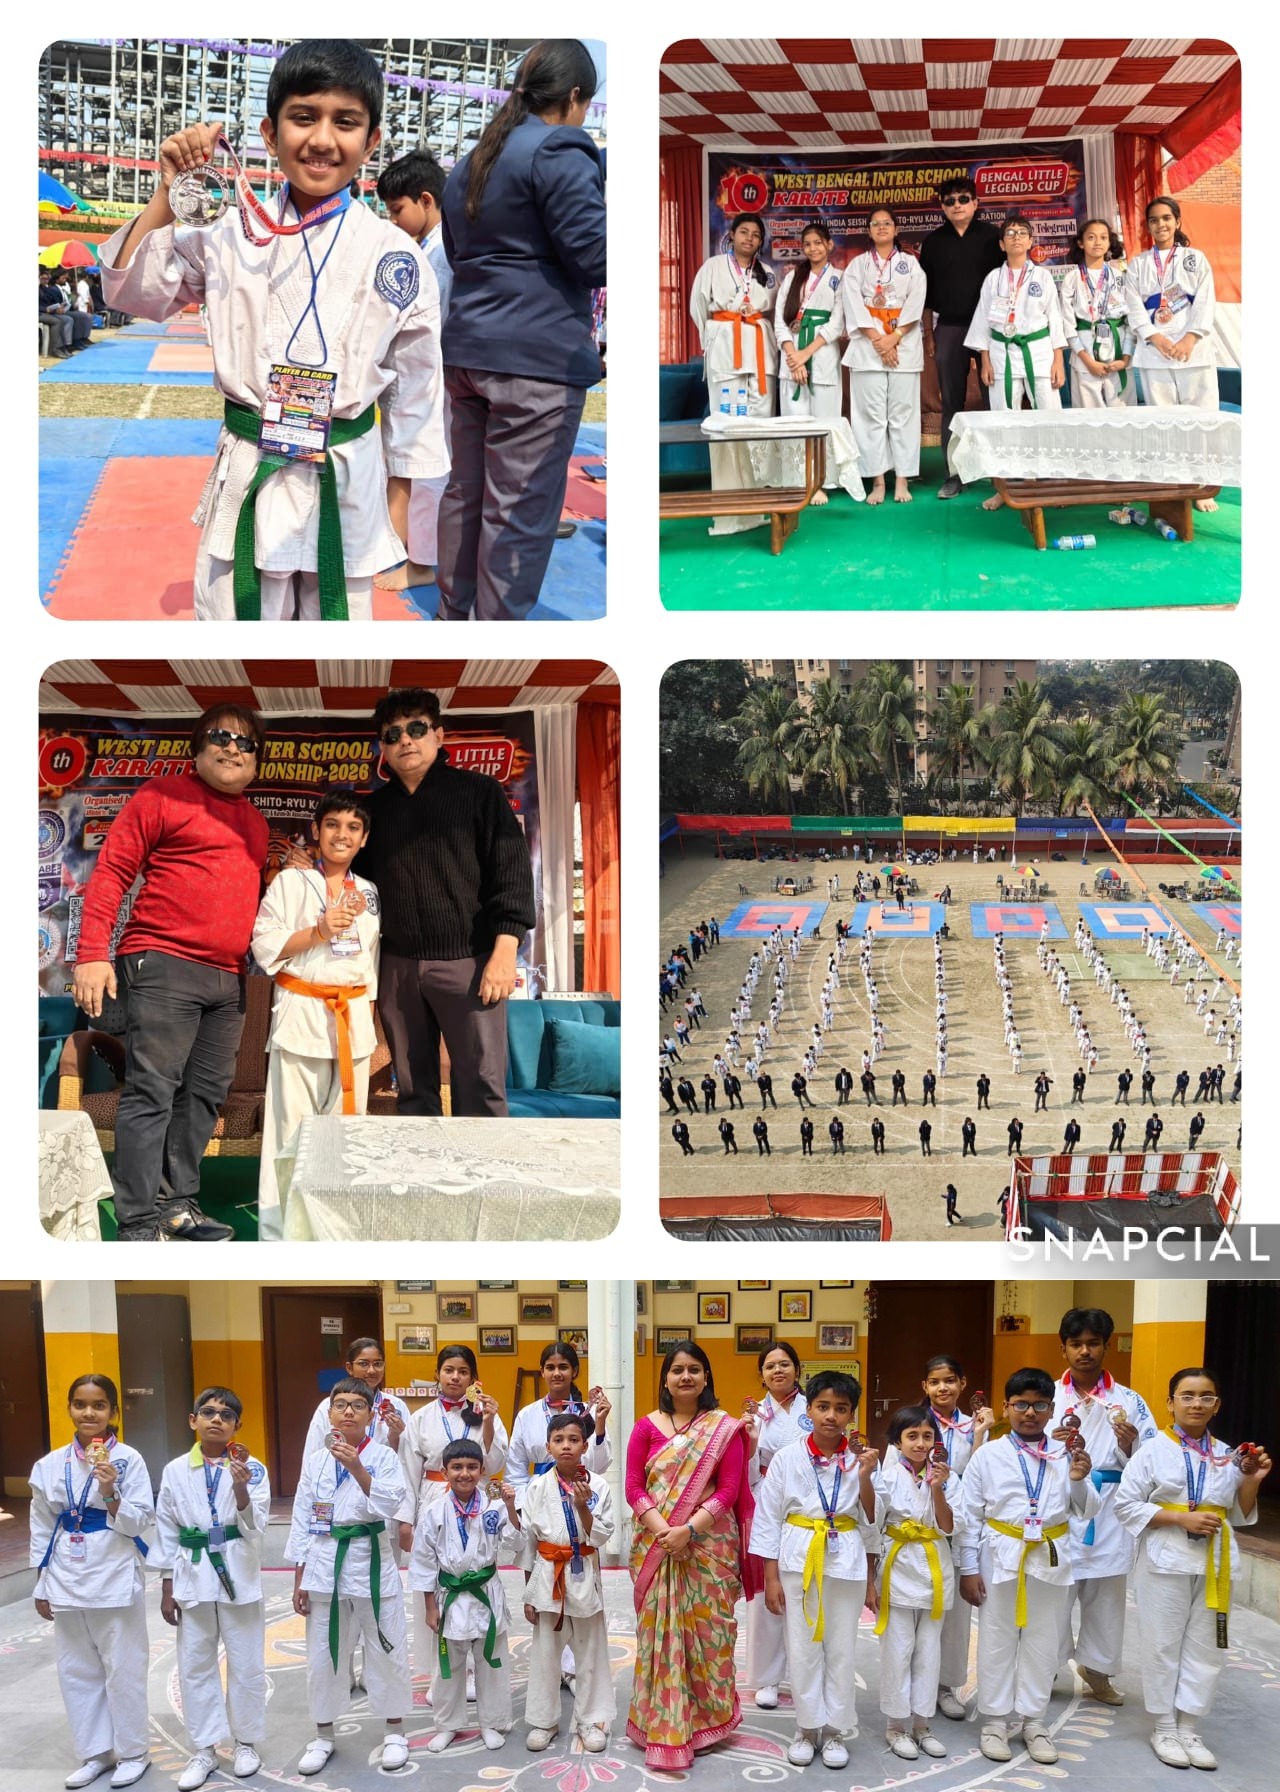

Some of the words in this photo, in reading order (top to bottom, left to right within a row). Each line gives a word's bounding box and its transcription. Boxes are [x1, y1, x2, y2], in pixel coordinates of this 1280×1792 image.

[773, 173, 815, 189] WEST
[816, 171, 870, 189] BENGAL
[872, 169, 914, 187] INTER
[980, 172, 1024, 183] BENGAL
[1028, 168, 1063, 180] LITTLE
[743, 186, 757, 200] th
[985, 182, 1034, 194] LEGENDS
[1037, 180, 1060, 192] CUP
[772, 190, 849, 207] KARATE
[851, 187, 941, 205] CHAMPIONSHIP-
[827, 218, 846, 227] INDIA
[847, 218, 867, 227] SEISH
[898, 216, 924, 224] TO-RYU
[925, 214, 945, 223] KARA
[1035, 221, 1076, 236] Telegraph
[273, 366, 301, 376] PLAYER
[301, 369, 310, 377] ID
[310, 371, 333, 380] CARD
[97, 738, 156, 756] WEST
[155, 739, 192, 757] BEN
[264, 740, 295, 759] TER
[298, 740, 373, 761] SCHOOL
[455, 748, 506, 763] LITTLE
[53, 752, 71, 769] th
[258, 762, 370, 782] IONSHIP-2026
[84, 794, 123, 807] Organised
[253, 796, 306, 809] SHITO-RYU
